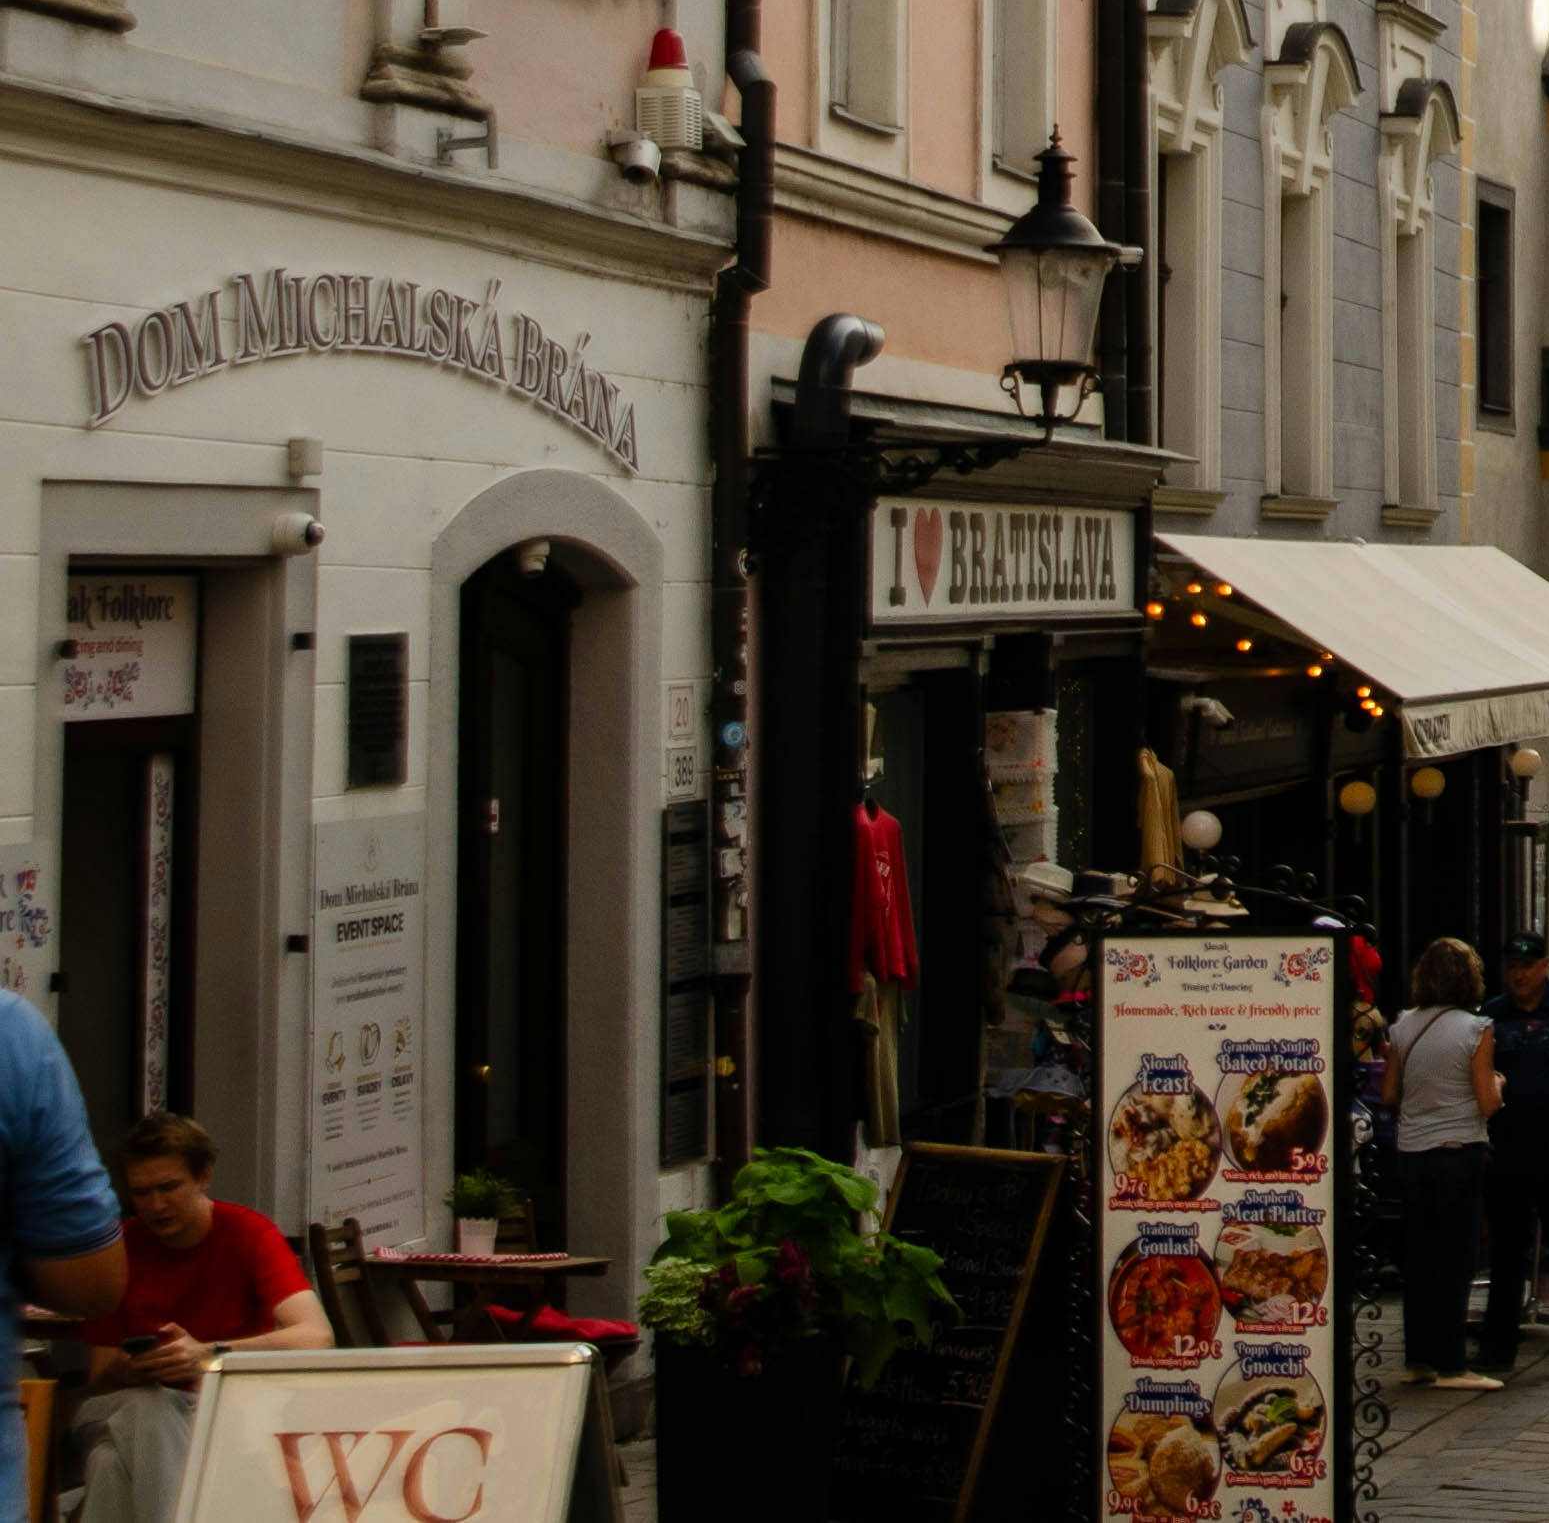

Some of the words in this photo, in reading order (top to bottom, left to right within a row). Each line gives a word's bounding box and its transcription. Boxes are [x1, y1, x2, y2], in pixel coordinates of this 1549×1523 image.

[84, 290, 228, 428] DOM
[234, 268, 510, 384] MICHALSKÁ
[514, 312, 641, 475] BRÁNA
[890, 507, 907, 606] I
[949, 510, 1116, 604] BRATISLAVA
[97, 583, 175, 630] Folklore
[675, 697, 689, 727] 20
[675, 755, 694, 787] 389
[337, 918, 370, 943] EVENT
[371, 911, 405, 937] SPACE
[1168, 955, 1221, 971] Folklore
[1223, 955, 1268, 971] Garden
[1113, 1002, 1178, 1018] Homemade,
[1180, 1002, 1208, 1018] Rich
[1209, 1004, 1235, 1017] taste
[1237, 1003, 1248, 1016] &
[1249, 1003, 1292, 1019] friendly
[1293, 1004, 1322, 1019] price
[1223, 1039, 1279, 1055] Grandma's
[1141, 1055, 1188, 1072] Slovak
[1217, 1054, 1268, 1075] Baked
[1271, 1055, 1324, 1073] Potato
[1137, 1070, 1193, 1094] Feast
[1244, 1190, 1304, 1206] Shepherd's
[1222, 1204, 1265, 1223] Meat
[1268, 1205, 1325, 1223] Platter
[1138, 1223, 1199, 1238] Traditional
[1137, 1237, 1199, 1259] Goulash
[1235, 1343, 1270, 1358] Poppy
[1272, 1343, 1311, 1357] Potato
[1241, 1358, 1305, 1380] Gnocchi
[1136, 1379, 1199, 1393] Homemade
[1125, 1393, 1211, 1417] Dumplings
[274, 1427, 493, 1523] WC
